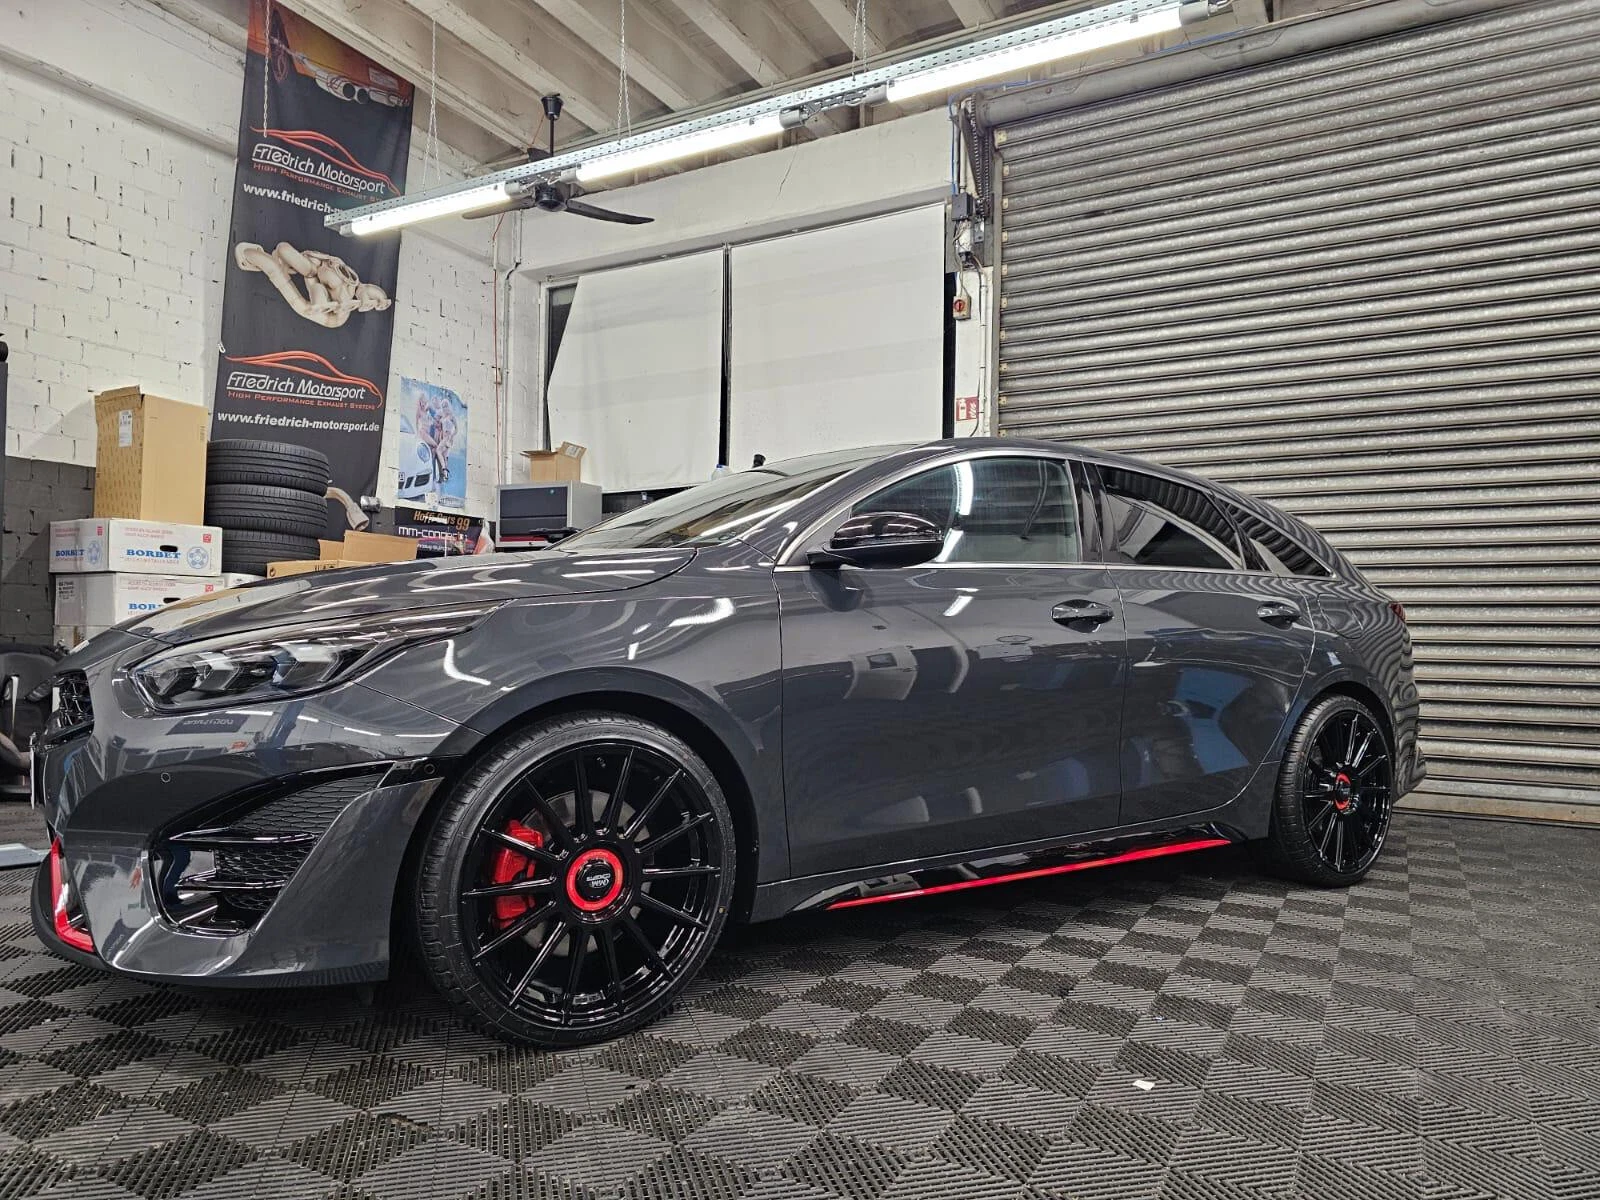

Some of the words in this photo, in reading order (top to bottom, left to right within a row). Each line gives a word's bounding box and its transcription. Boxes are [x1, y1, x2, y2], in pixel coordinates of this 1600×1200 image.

[252, 144, 314, 173] Friedrich
[317, 162, 386, 194] Motorsport
[227, 371, 294, 392] Friedrich
[297, 379, 365, 401] Motorsport
[228, 391, 251, 399] HIGH
[254, 394, 315, 406] PERFORMANCE
[317, 400, 348, 409] EXHAUST
[217, 411, 380, 432] www.friedrich-motorsport.de
[456, 517, 470, 531] 99
[126, 549, 181, 559] BORBET
